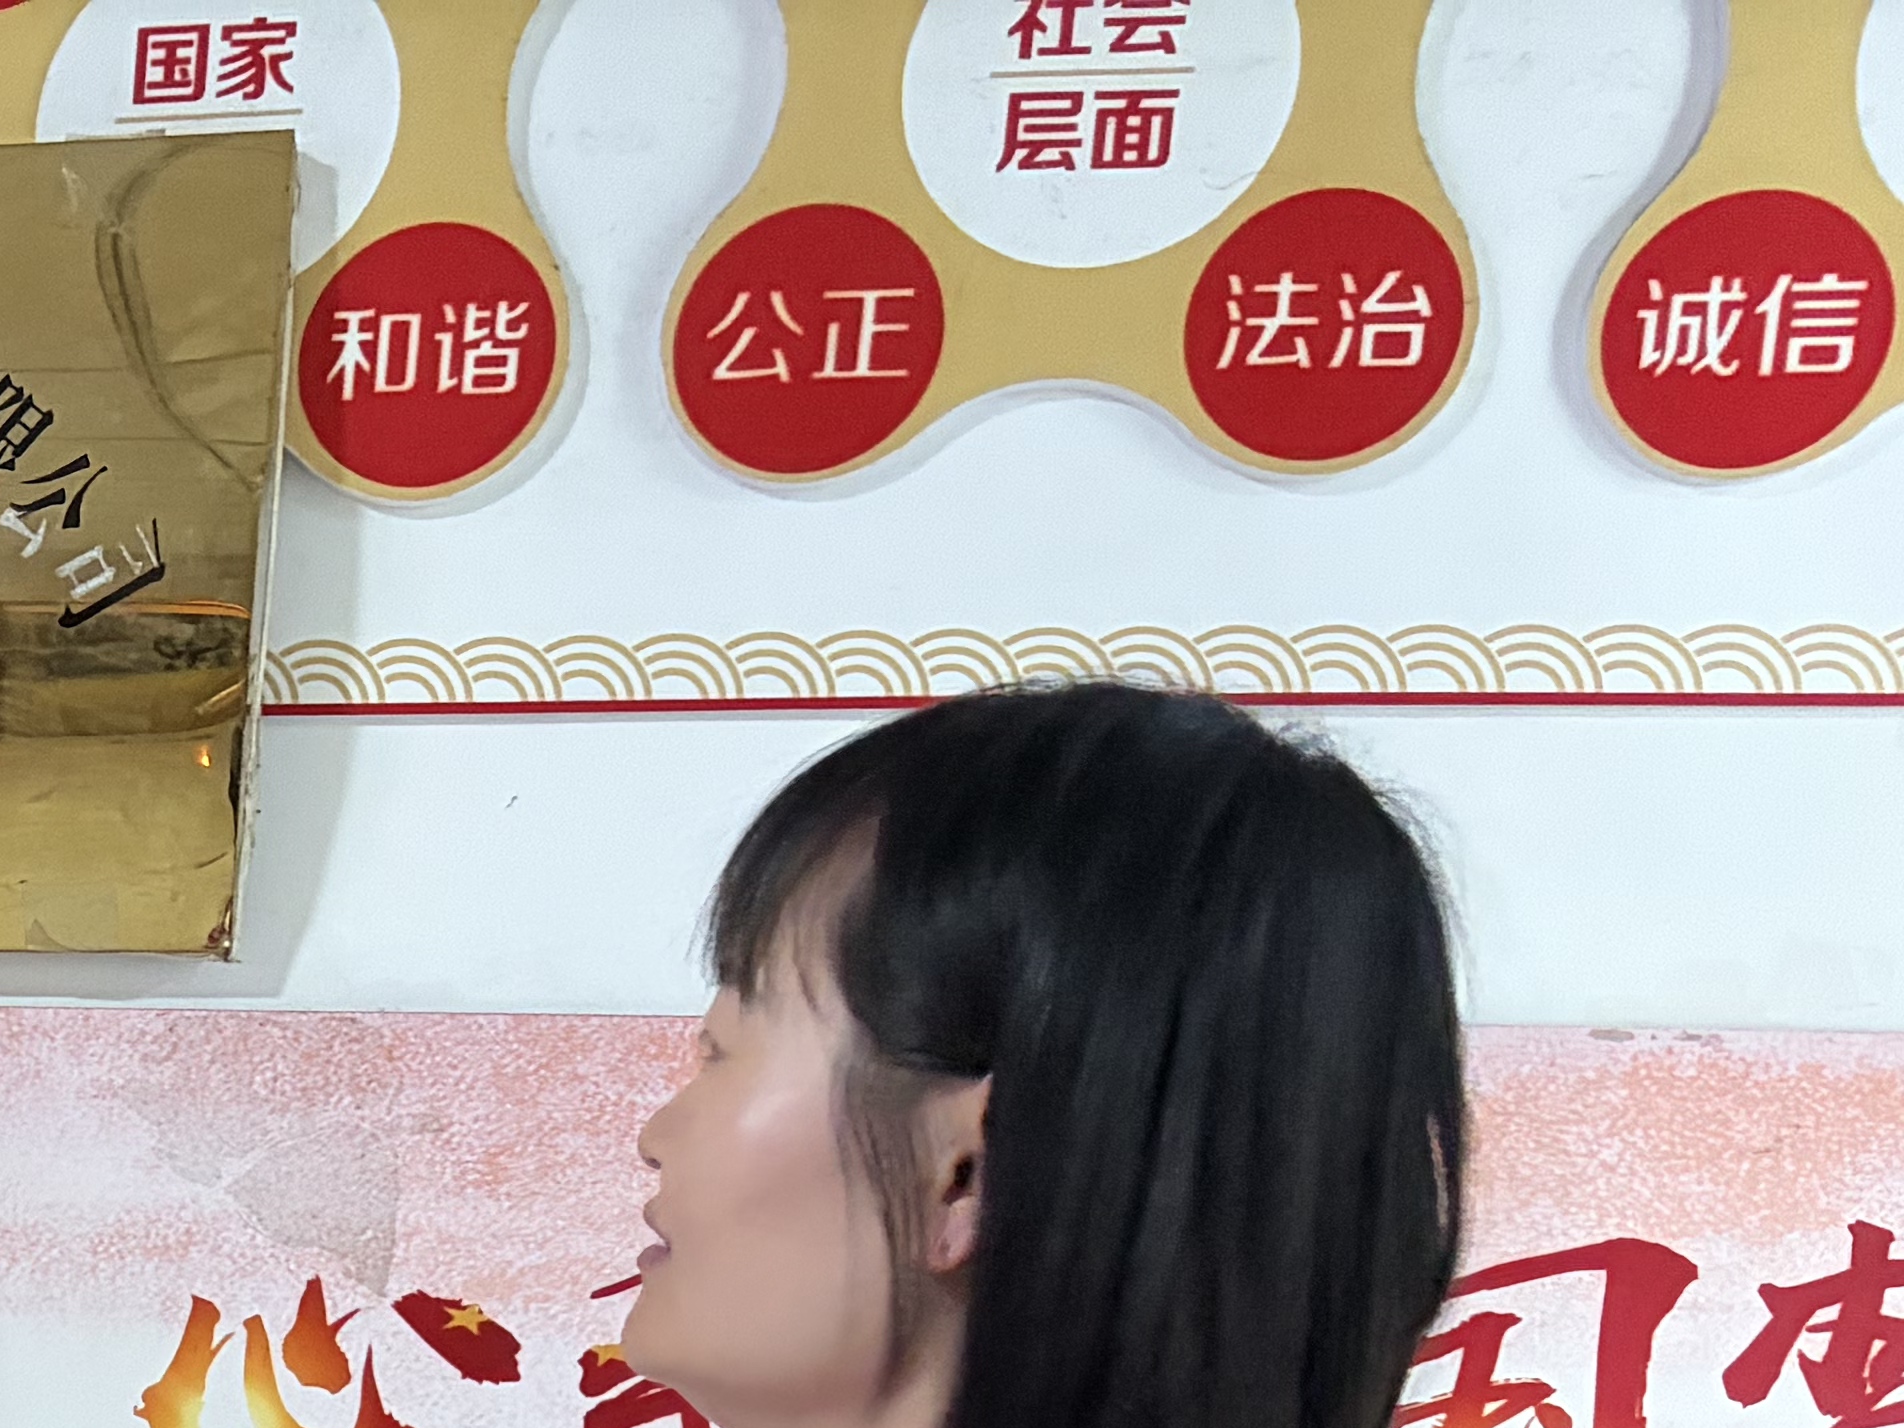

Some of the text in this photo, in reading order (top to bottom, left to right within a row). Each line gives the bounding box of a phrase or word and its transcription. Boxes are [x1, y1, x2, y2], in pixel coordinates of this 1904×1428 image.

[133, 17, 298, 105] 国家
[1007, 0, 1191, 60] 社会
[995, 89, 1180, 172] 层面
[327, 300, 530, 400] 和谐
[707, 287, 915, 382] 公正
[1214, 269, 1433, 371] 法治
[1636, 272, 1869, 377] 诚信
